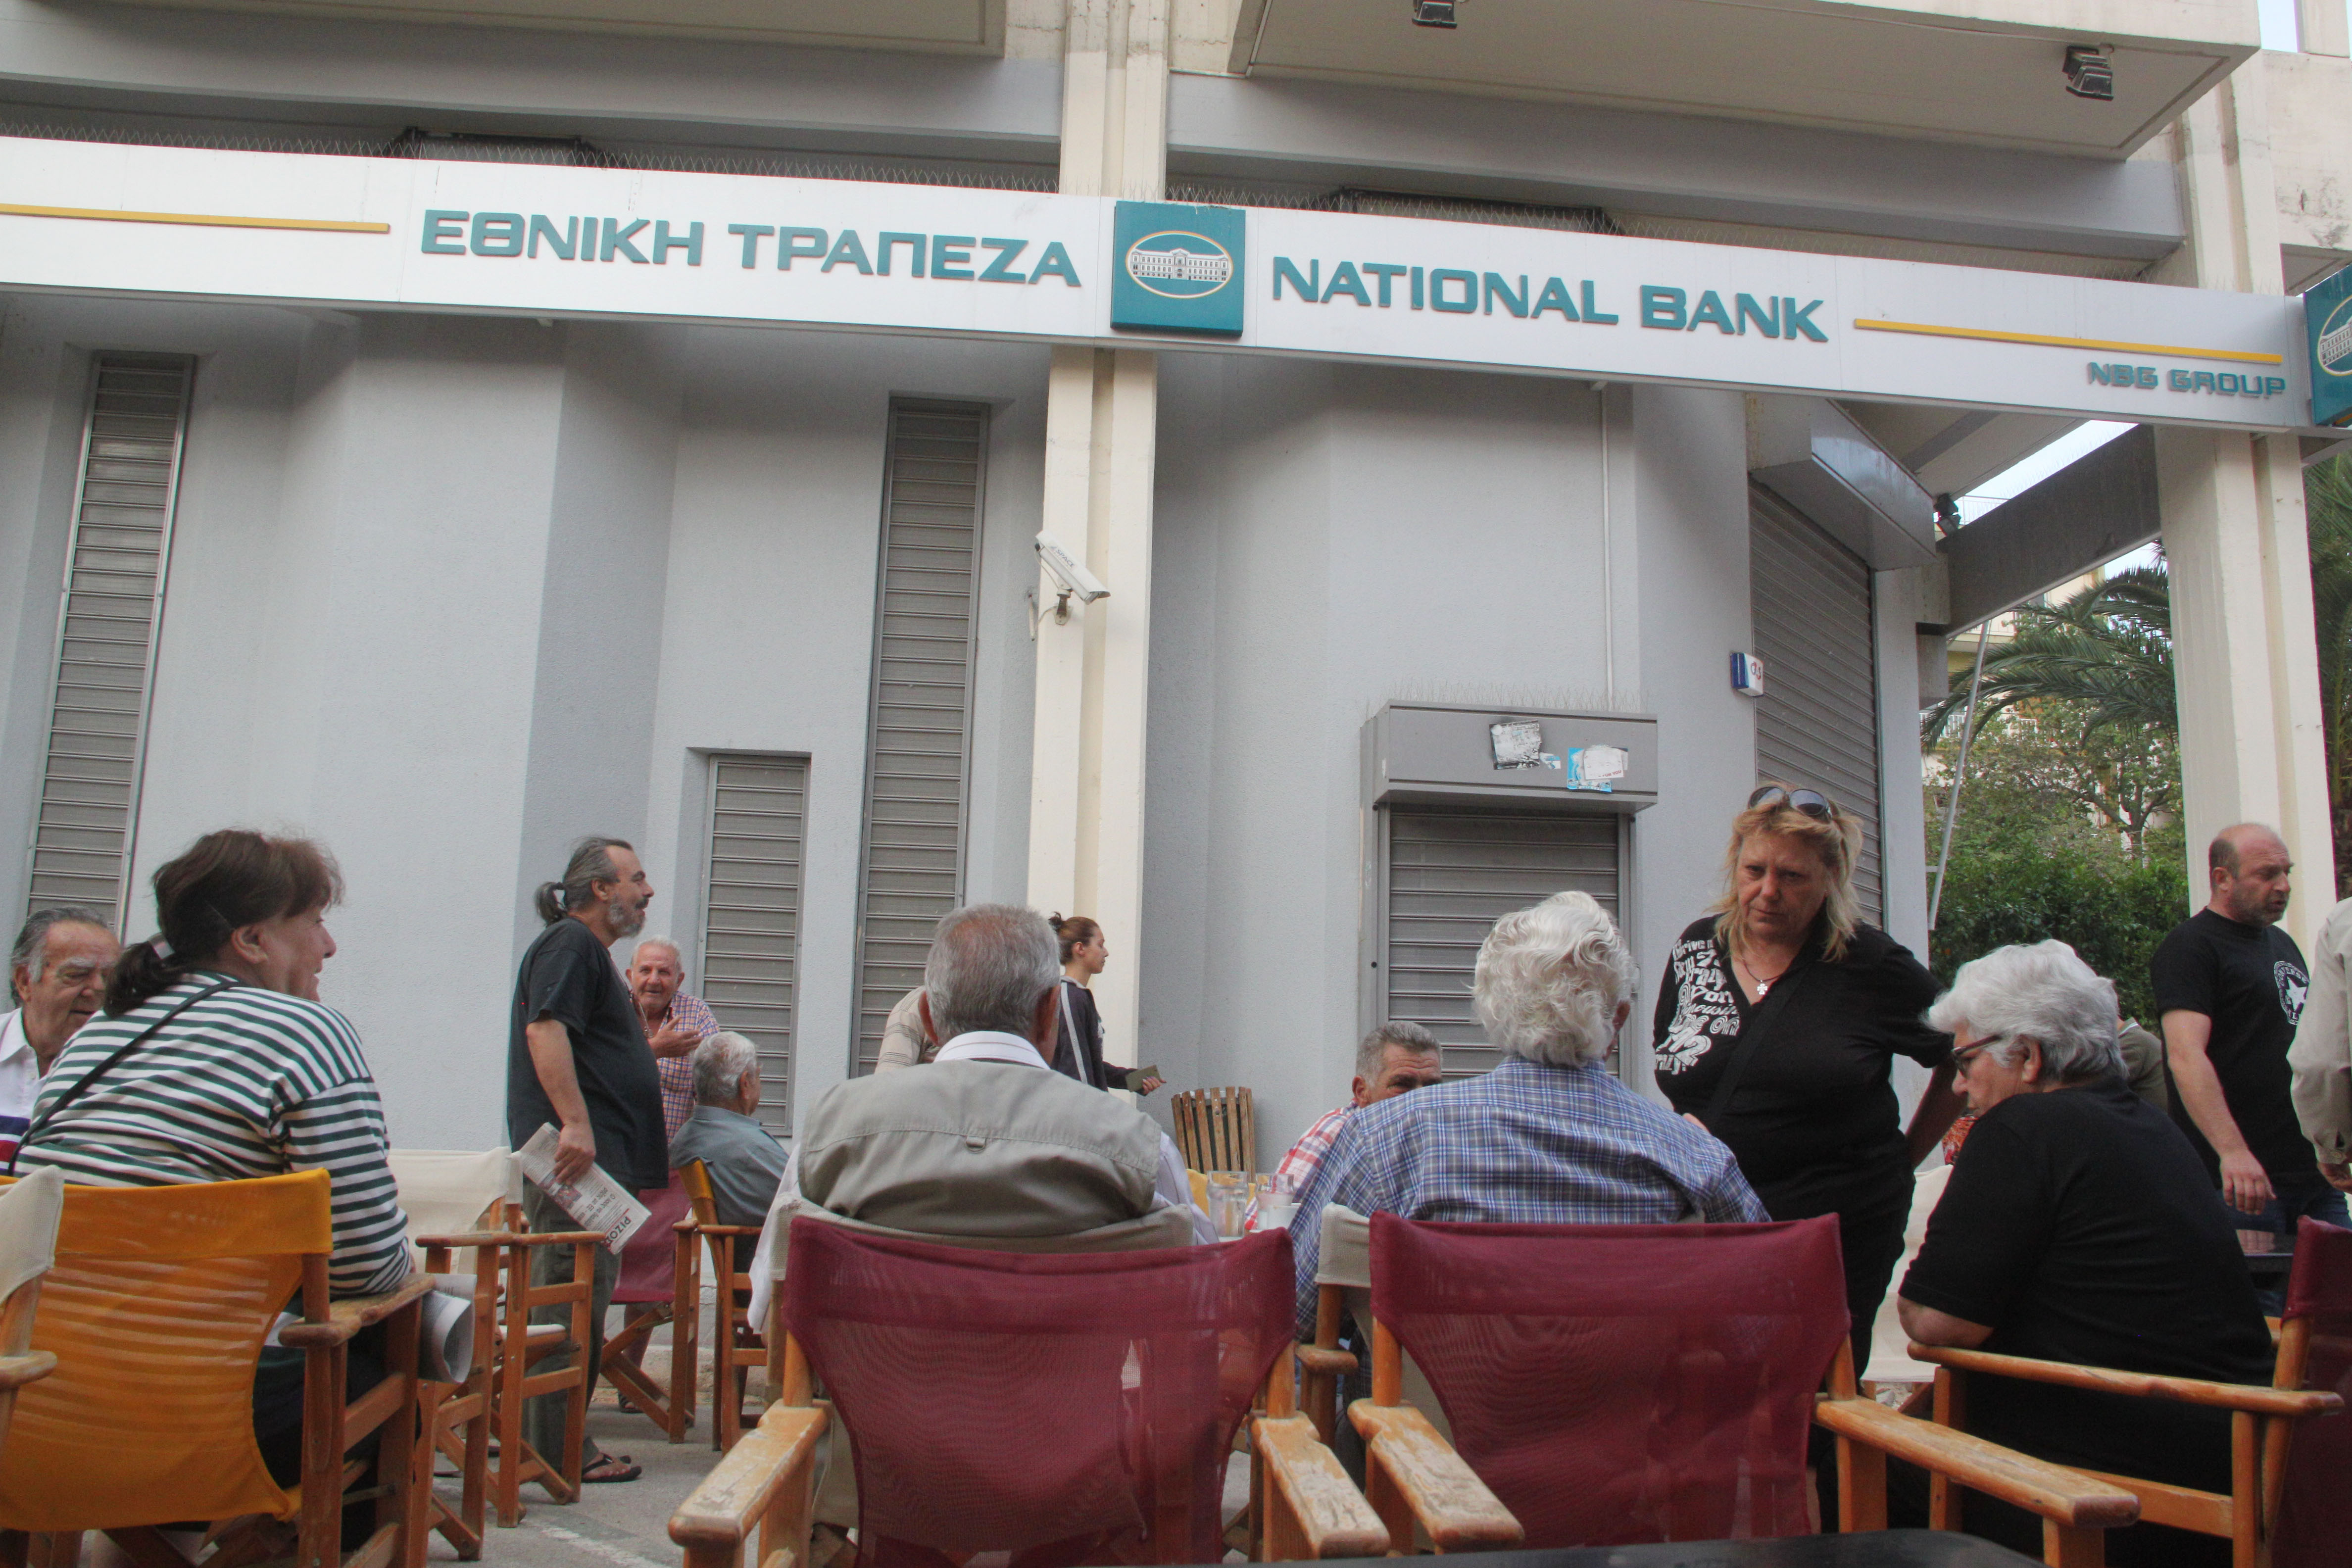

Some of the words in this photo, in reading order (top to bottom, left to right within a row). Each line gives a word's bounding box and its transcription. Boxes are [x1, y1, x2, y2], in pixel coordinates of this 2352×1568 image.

[421, 209, 703, 267] ΕΘΝΙΚΗ
[728, 223, 1081, 287] ΤΡΑΠΕΖΑ
[1272, 255, 1619, 324] NATIONAL
[1640, 284, 1830, 343] BANK
[2088, 361, 2159, 389] NBG
[2168, 368, 2287, 398] GROUP
